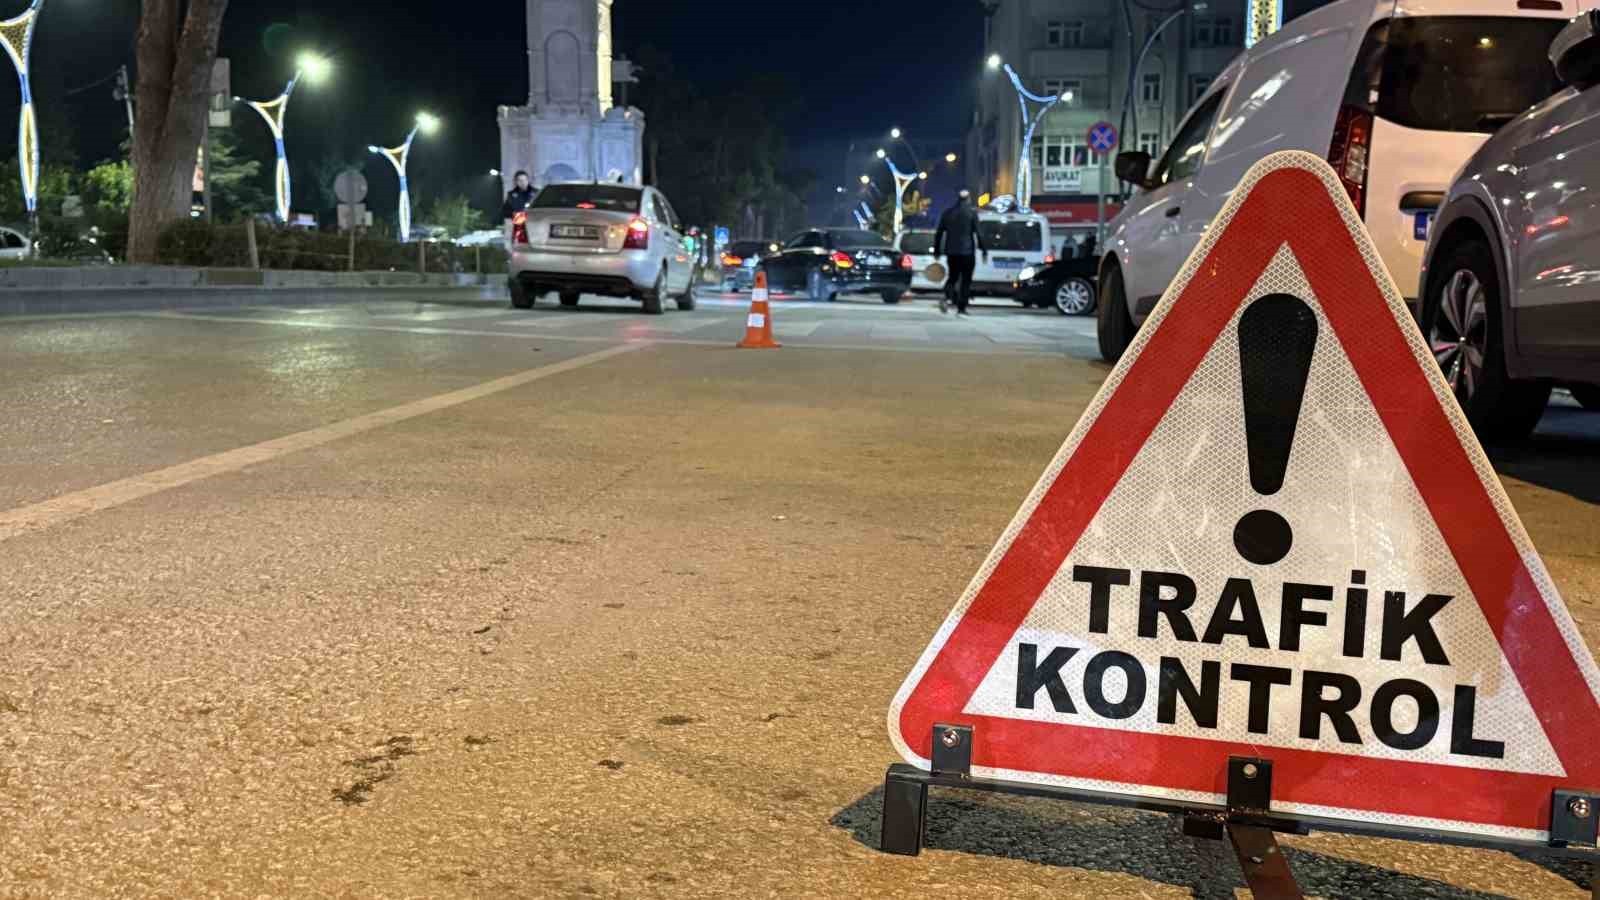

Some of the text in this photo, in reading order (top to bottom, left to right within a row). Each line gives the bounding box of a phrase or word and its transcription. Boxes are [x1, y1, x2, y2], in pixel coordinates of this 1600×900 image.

[1045, 170, 1080, 181] AVUKAT
[1073, 565, 1453, 665] TRAFİK
[1015, 643, 1505, 759] KONTROL
